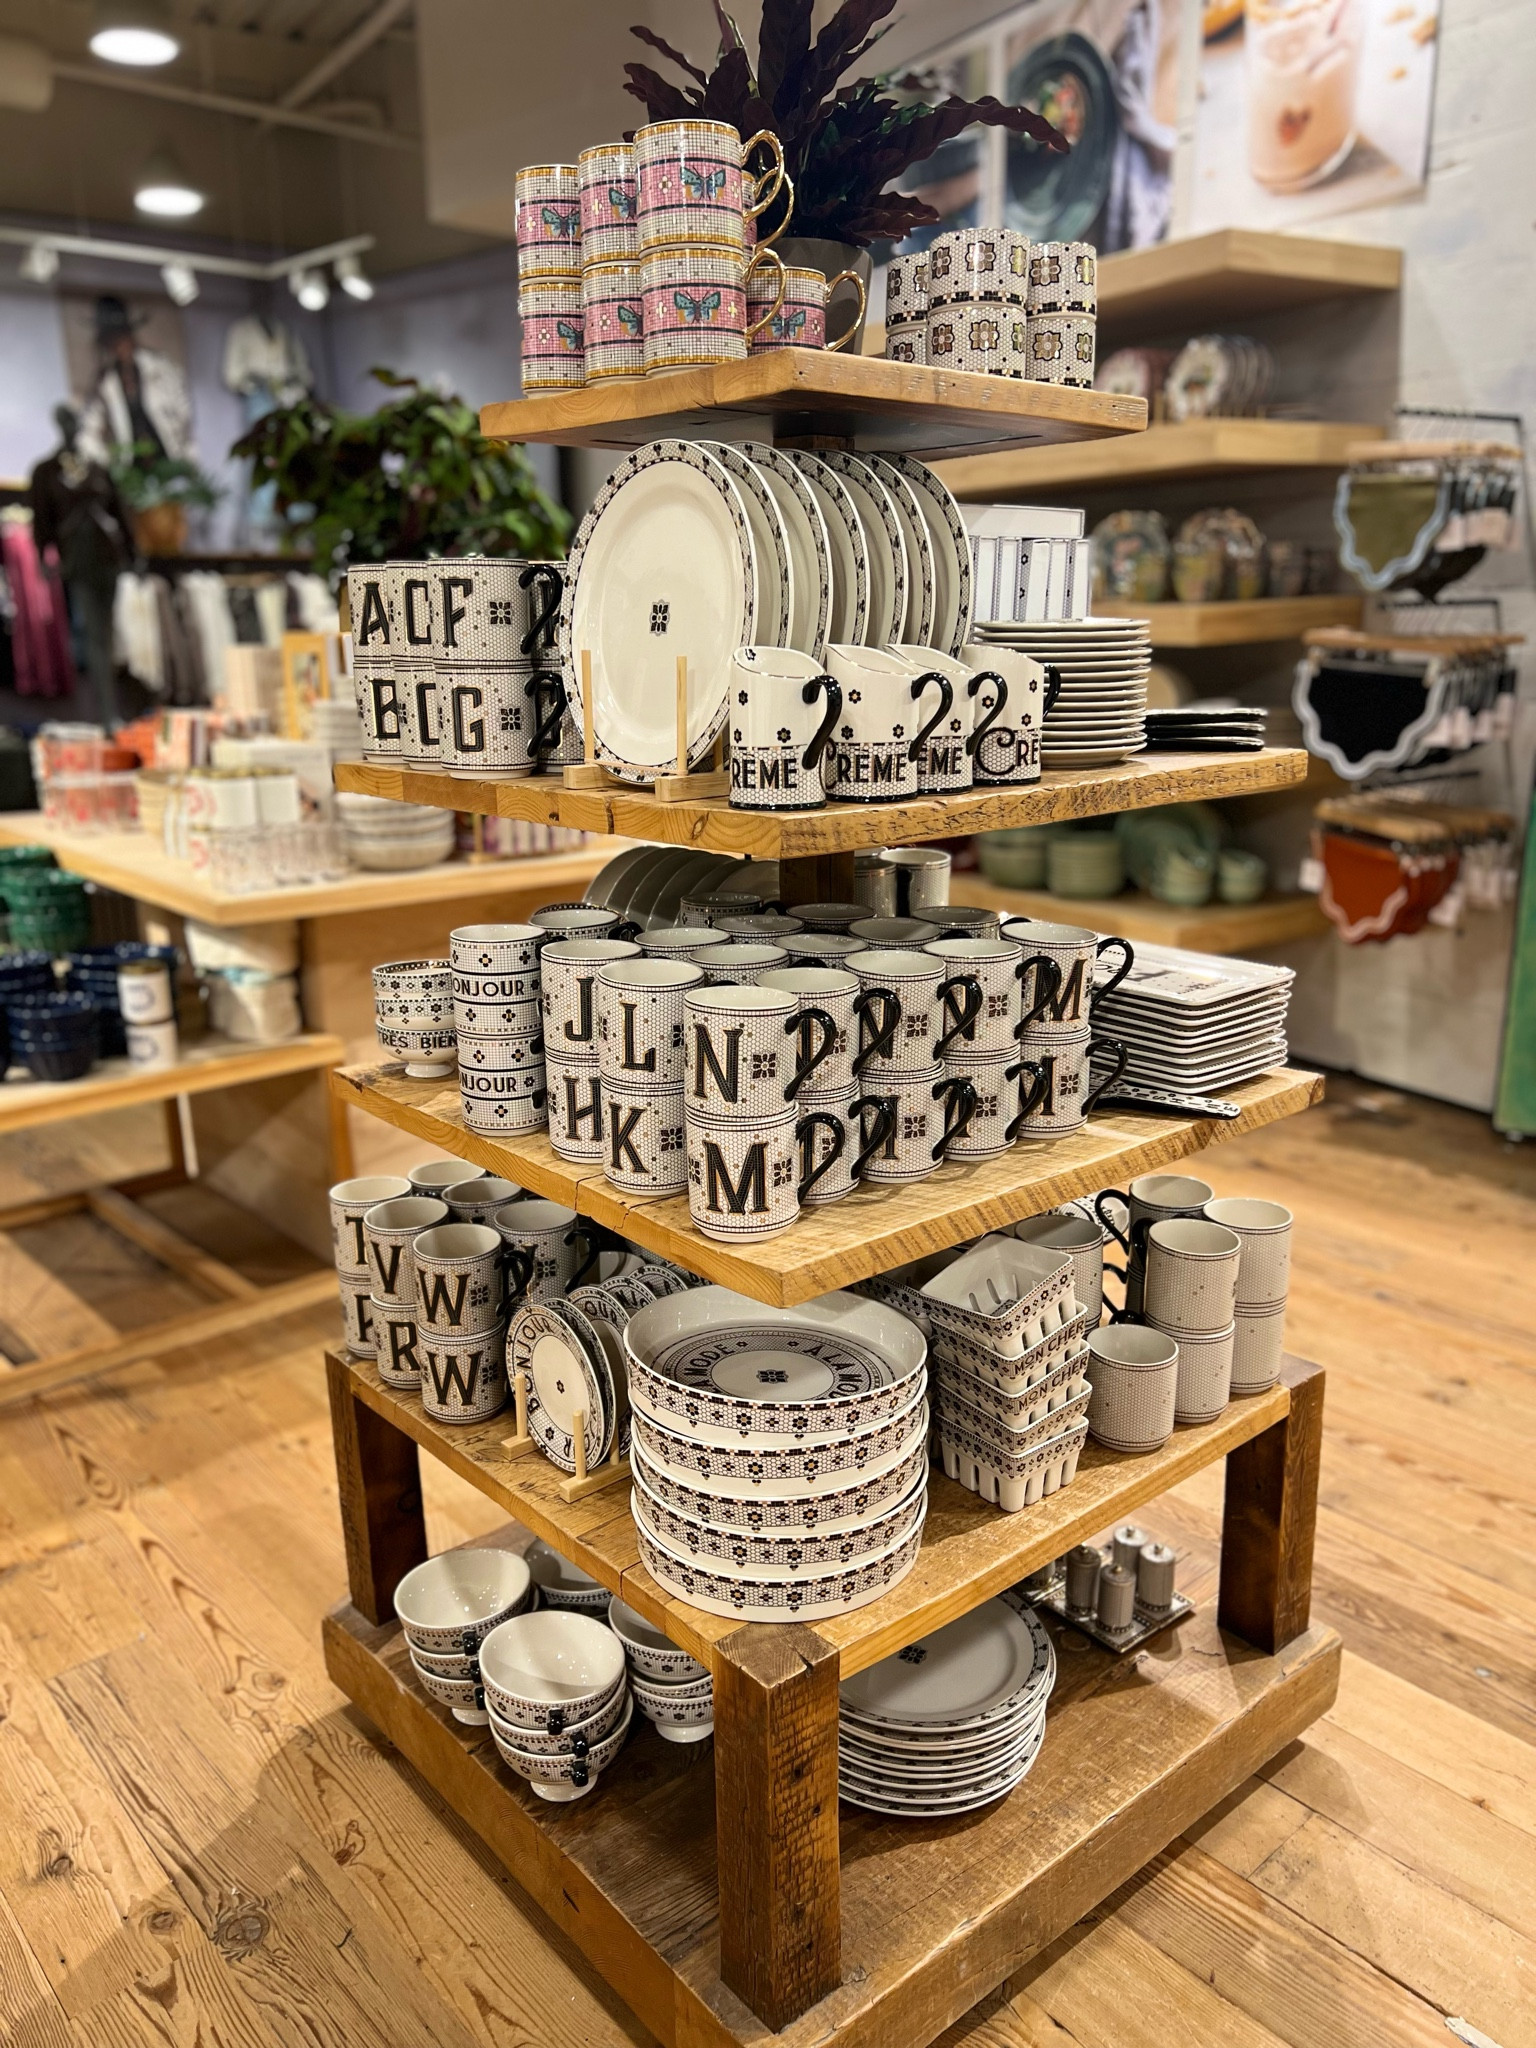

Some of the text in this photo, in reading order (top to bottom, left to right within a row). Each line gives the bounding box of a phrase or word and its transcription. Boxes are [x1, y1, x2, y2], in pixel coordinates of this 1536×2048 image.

[358, 582, 391, 646] A
[404, 579, 431, 645] C
[439, 578, 474, 648] F
[452, 686, 485, 753] G
[732, 752, 797, 789] RÈME
[975, 726, 1038, 776] CRÈ
[453, 977, 524, 997] ONJOUR
[564, 976, 595, 1042] J
[620, 1000, 657, 1073] L
[692, 1023, 743, 1105] N
[460, 1072, 517, 1093] NJOUR
[562, 1075, 602, 1142] H
[608, 1101, 650, 1174] K
[701, 1139, 769, 1216] M
[370, 1241, 405, 1295] V
[416, 1267, 472, 1327] W
[385, 1320, 421, 1373] R
[683, 1343, 736, 1377] MODE
[1014, 1319, 1085, 1375] MON CHER
[425, 1349, 485, 1407] W
[827, 1372, 864, 1399] MOD
[1018, 1356, 1088, 1411] MON CHER
